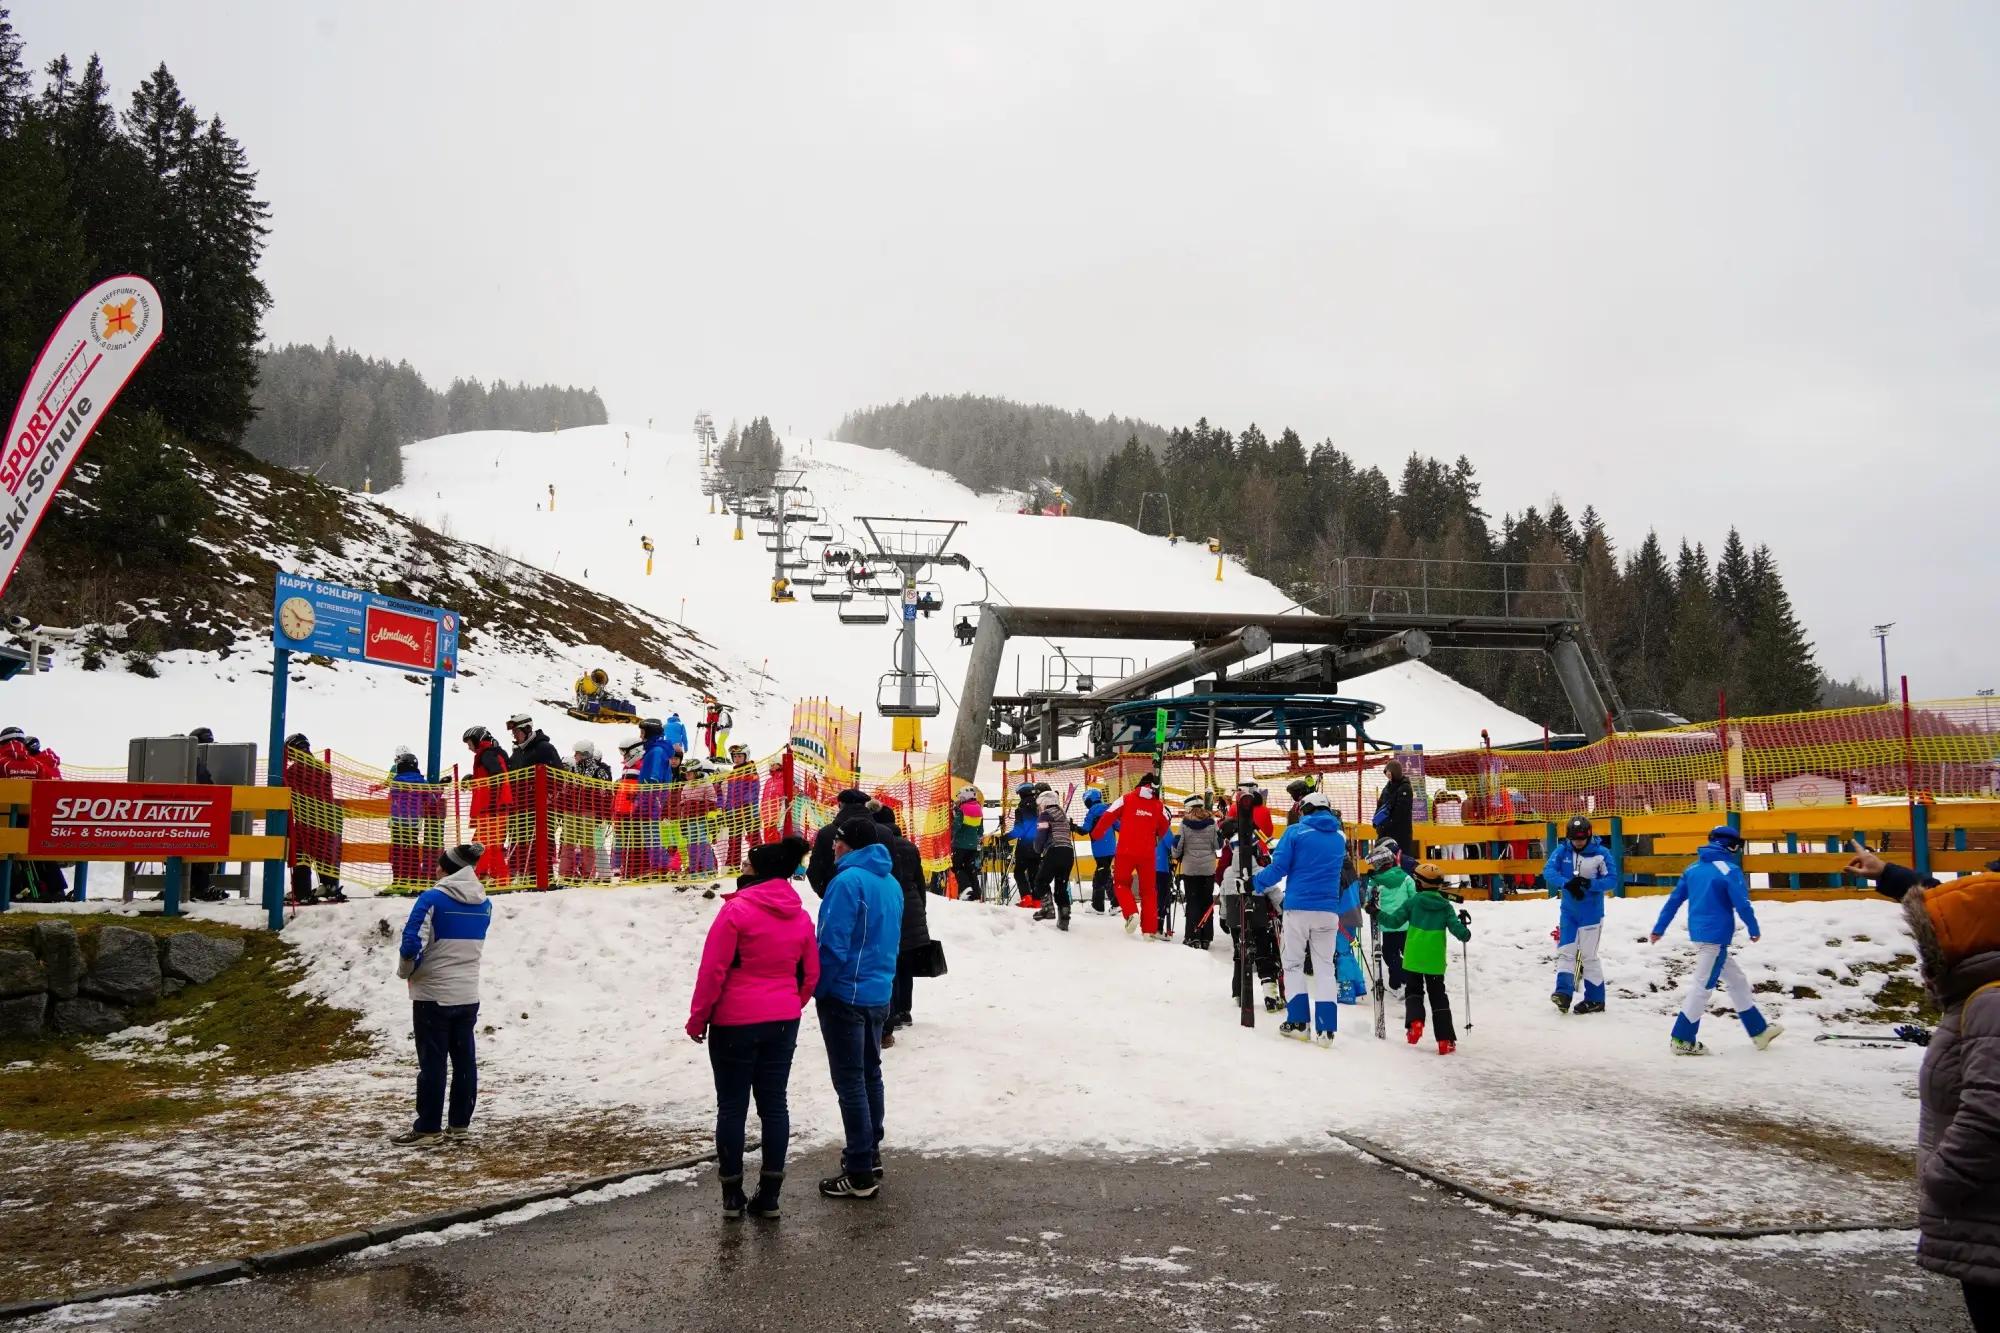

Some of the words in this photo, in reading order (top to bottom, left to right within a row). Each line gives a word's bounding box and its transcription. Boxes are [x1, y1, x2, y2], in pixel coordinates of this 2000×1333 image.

[98, 287, 137, 305] TREFFPUNKT
[0, 396, 92, 550] Ski-Schule
[279, 576, 314, 592] HAPPY
[316, 584, 363, 603] SCHLEPPI
[371, 626, 421, 651] Almdudler
[50, 827, 76, 837] Ski-
[80, 827, 89, 837] &
[94, 828, 211, 839] Snowboard-Schule
